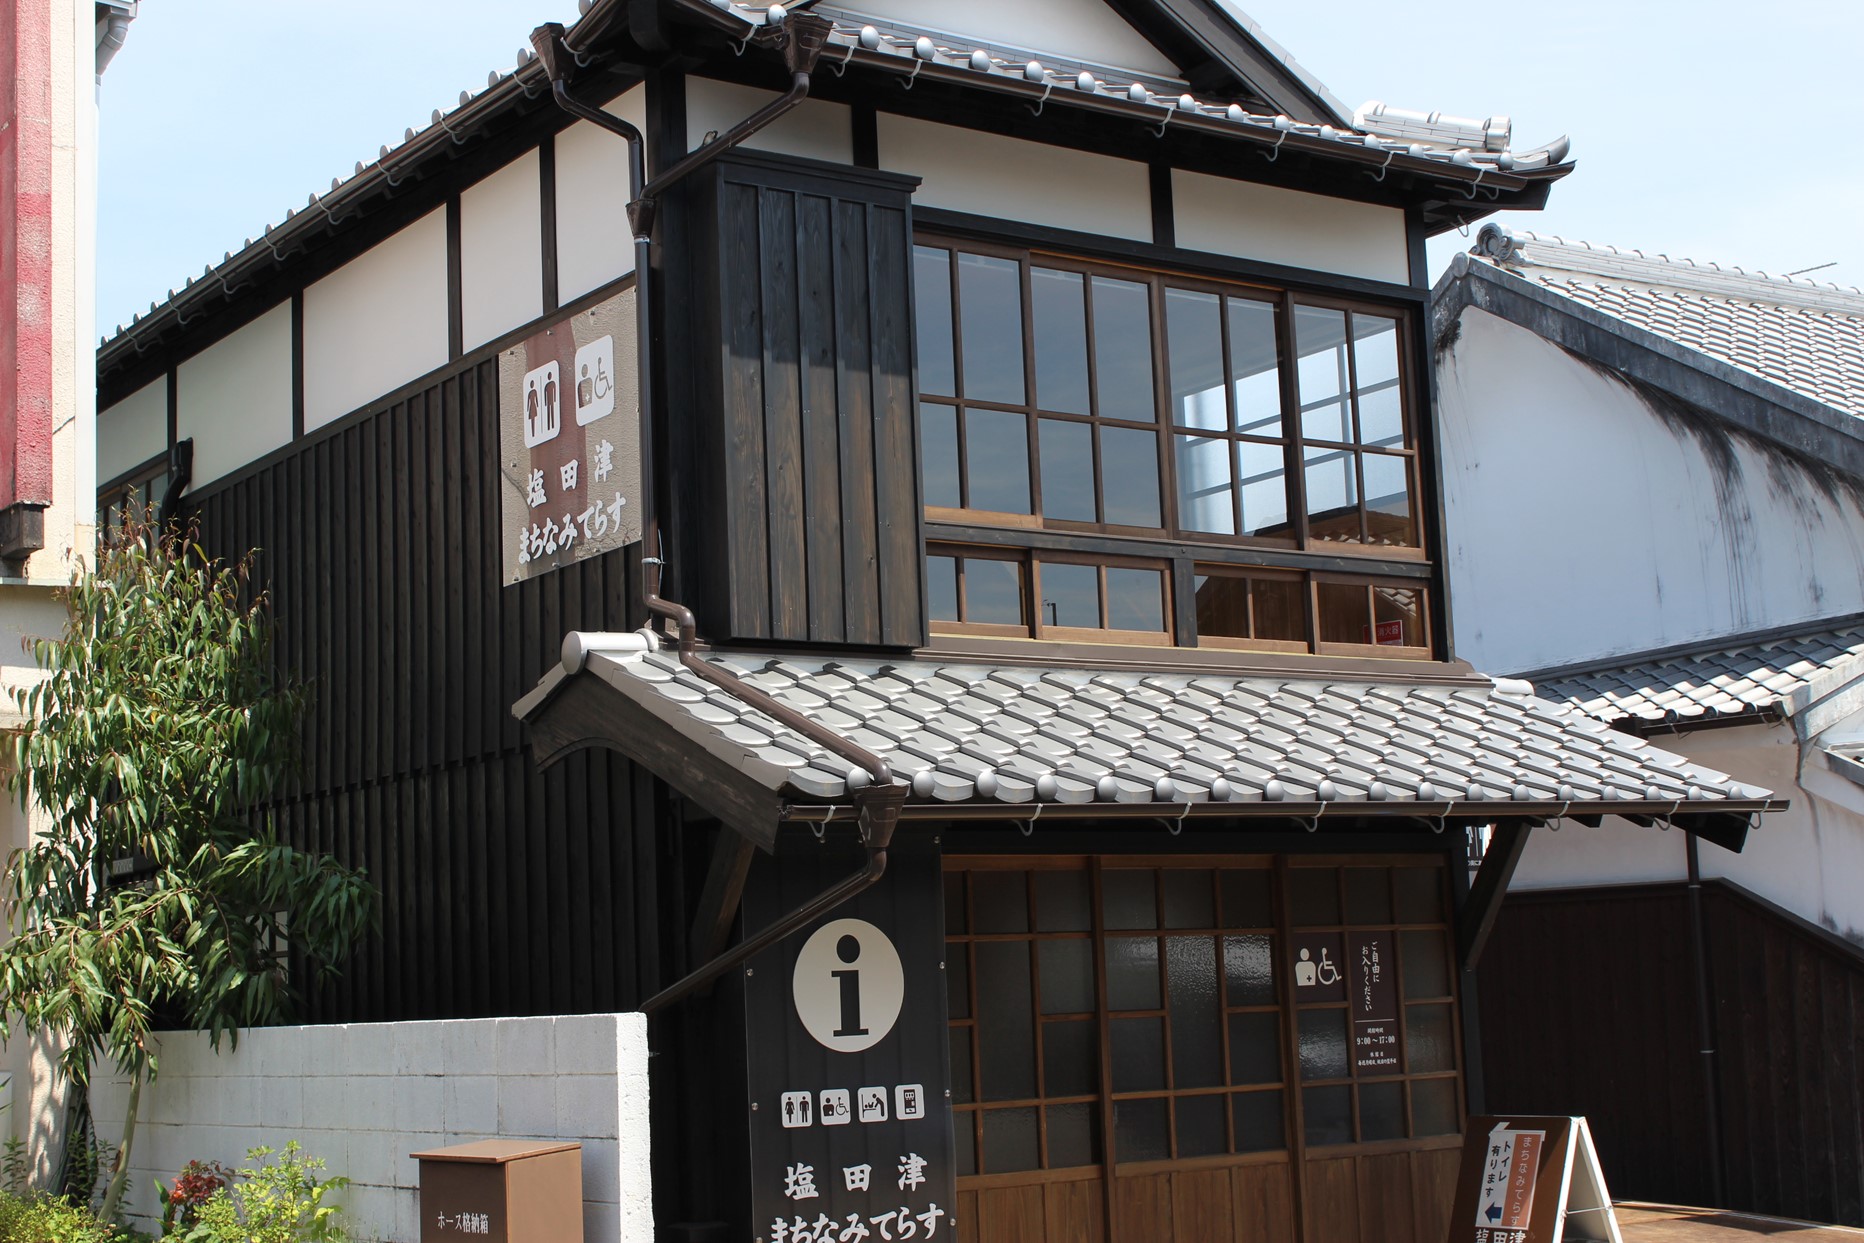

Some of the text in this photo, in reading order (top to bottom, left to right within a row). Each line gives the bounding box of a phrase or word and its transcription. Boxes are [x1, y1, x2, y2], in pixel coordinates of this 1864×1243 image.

[527, 439, 614, 508] 塩田津
[518, 492, 627, 564] まちなみてらす
[1362, 945, 1372, 1012] お入りください
[1371, 941, 1380, 983] ご自由に
[784, 1152, 928, 1200] 塩田津
[1485, 1145, 1501, 1198] 有ります
[1498, 1141, 1511, 1182] トイレ
[1511, 1137, 1532, 1226] まちなみてらす
[437, 1211, 489, 1235] ホース格納箱
[770, 1202, 945, 1243] まちなみてらす
